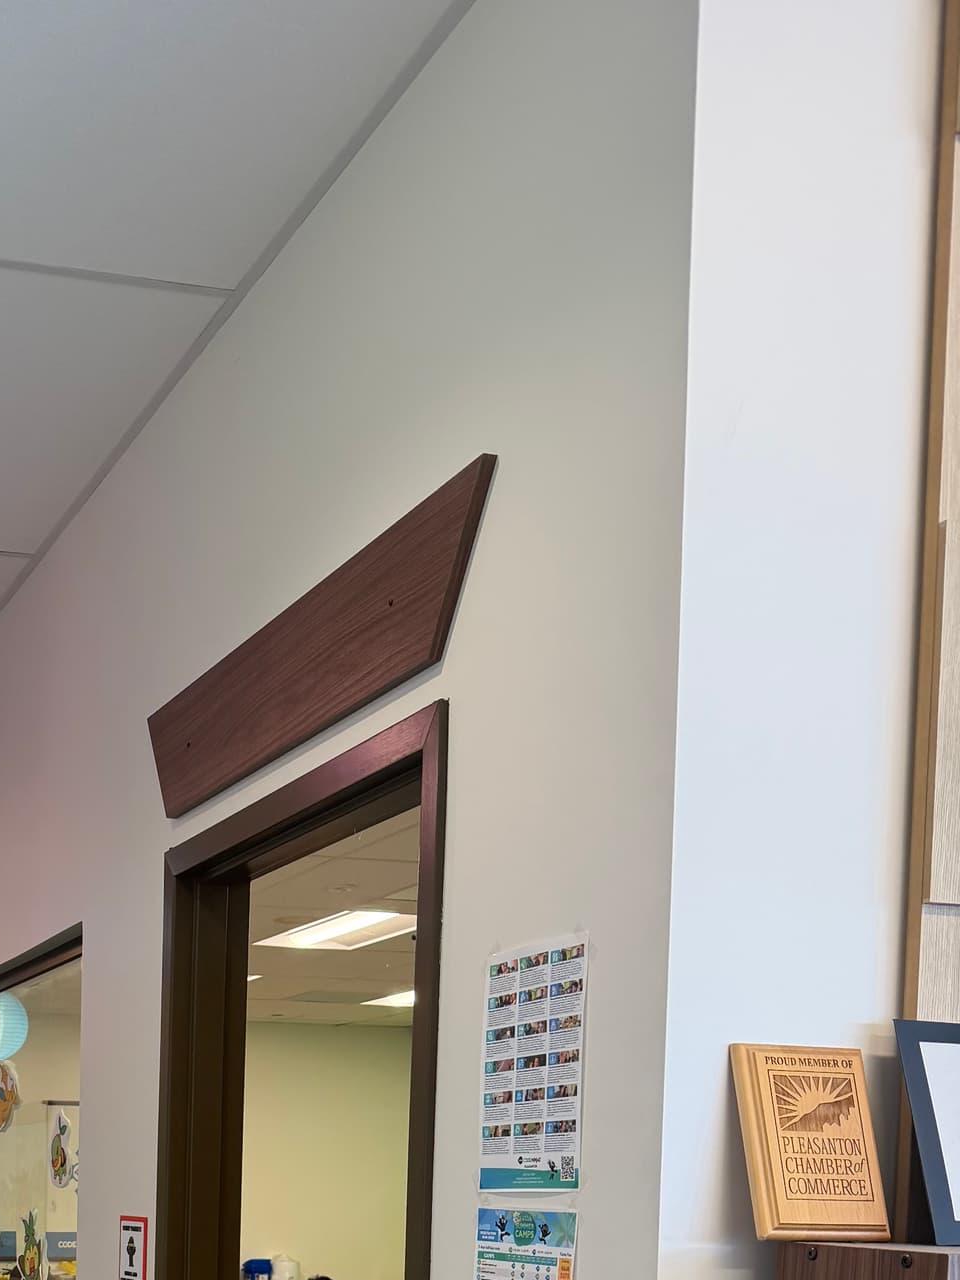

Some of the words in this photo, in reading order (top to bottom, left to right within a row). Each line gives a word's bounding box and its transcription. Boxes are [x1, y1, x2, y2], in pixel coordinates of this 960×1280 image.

[764, 1055, 797, 1066] PROUD
[798, 1057, 839, 1068] MEMBER
[841, 1059, 853, 1069] OF
[781, 1135, 862, 1156] PLEASANTON
[785, 1156, 855, 1176] CHAMBER
[853, 1157, 866, 1173] of
[788, 1176, 869, 1197] COMMERCE
